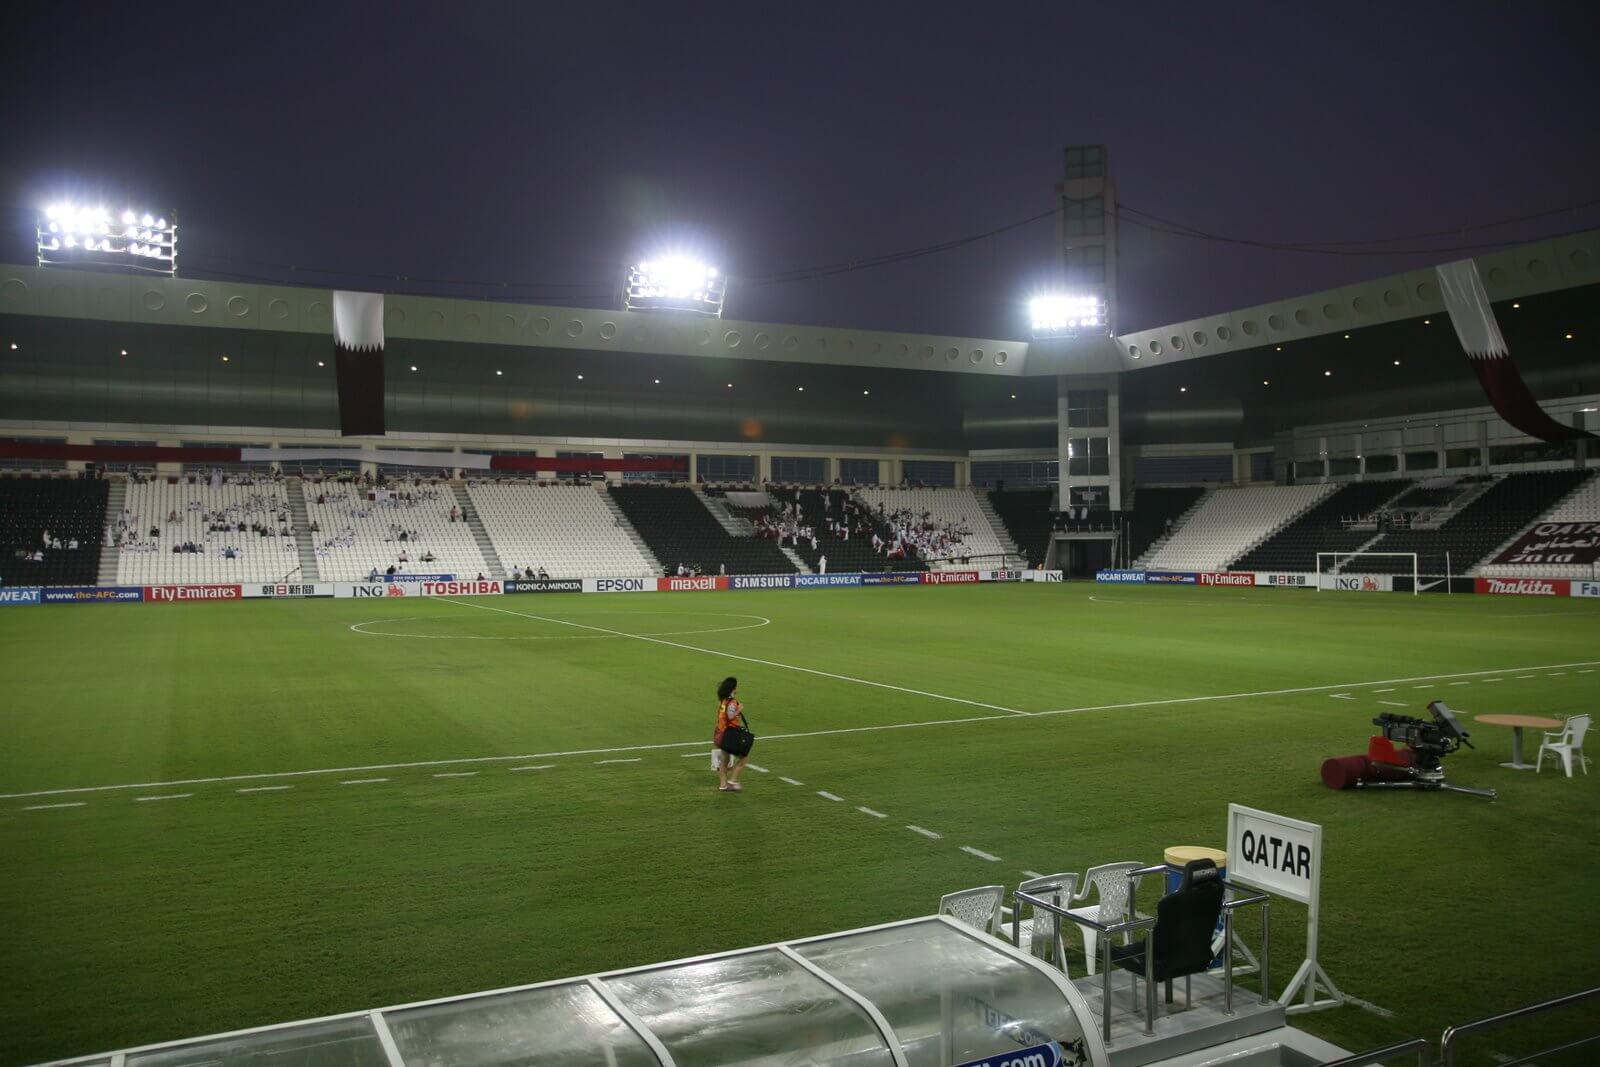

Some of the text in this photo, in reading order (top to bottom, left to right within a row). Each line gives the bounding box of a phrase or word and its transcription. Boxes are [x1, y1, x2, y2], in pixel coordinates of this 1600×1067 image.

[734, 576, 790, 588] SAMSUNG
[795, 575, 860, 586] POCARI SWEAT
[925, 572, 976, 585] Fly Emirates
[1096, 572, 1144, 581] POCARI SWEAT
[1201, 573, 1252, 586] Fly Emirates
[262, 584, 315, 595] 朝日新聞
[423, 581, 501, 595] TOSHIBA
[516, 581, 582, 591] KONICA MINOLTA
[596, 578, 644, 591] EPSON
[670, 577, 716, 590] maxell
[1582, 582, 1600, 596] Fa
[46, 591, 139, 600] www.the-AFC.com
[152, 585, 236, 601] Fly Emirates
[352, 585, 383, 597] ING
[1241, 830, 1311, 880] QATAR
